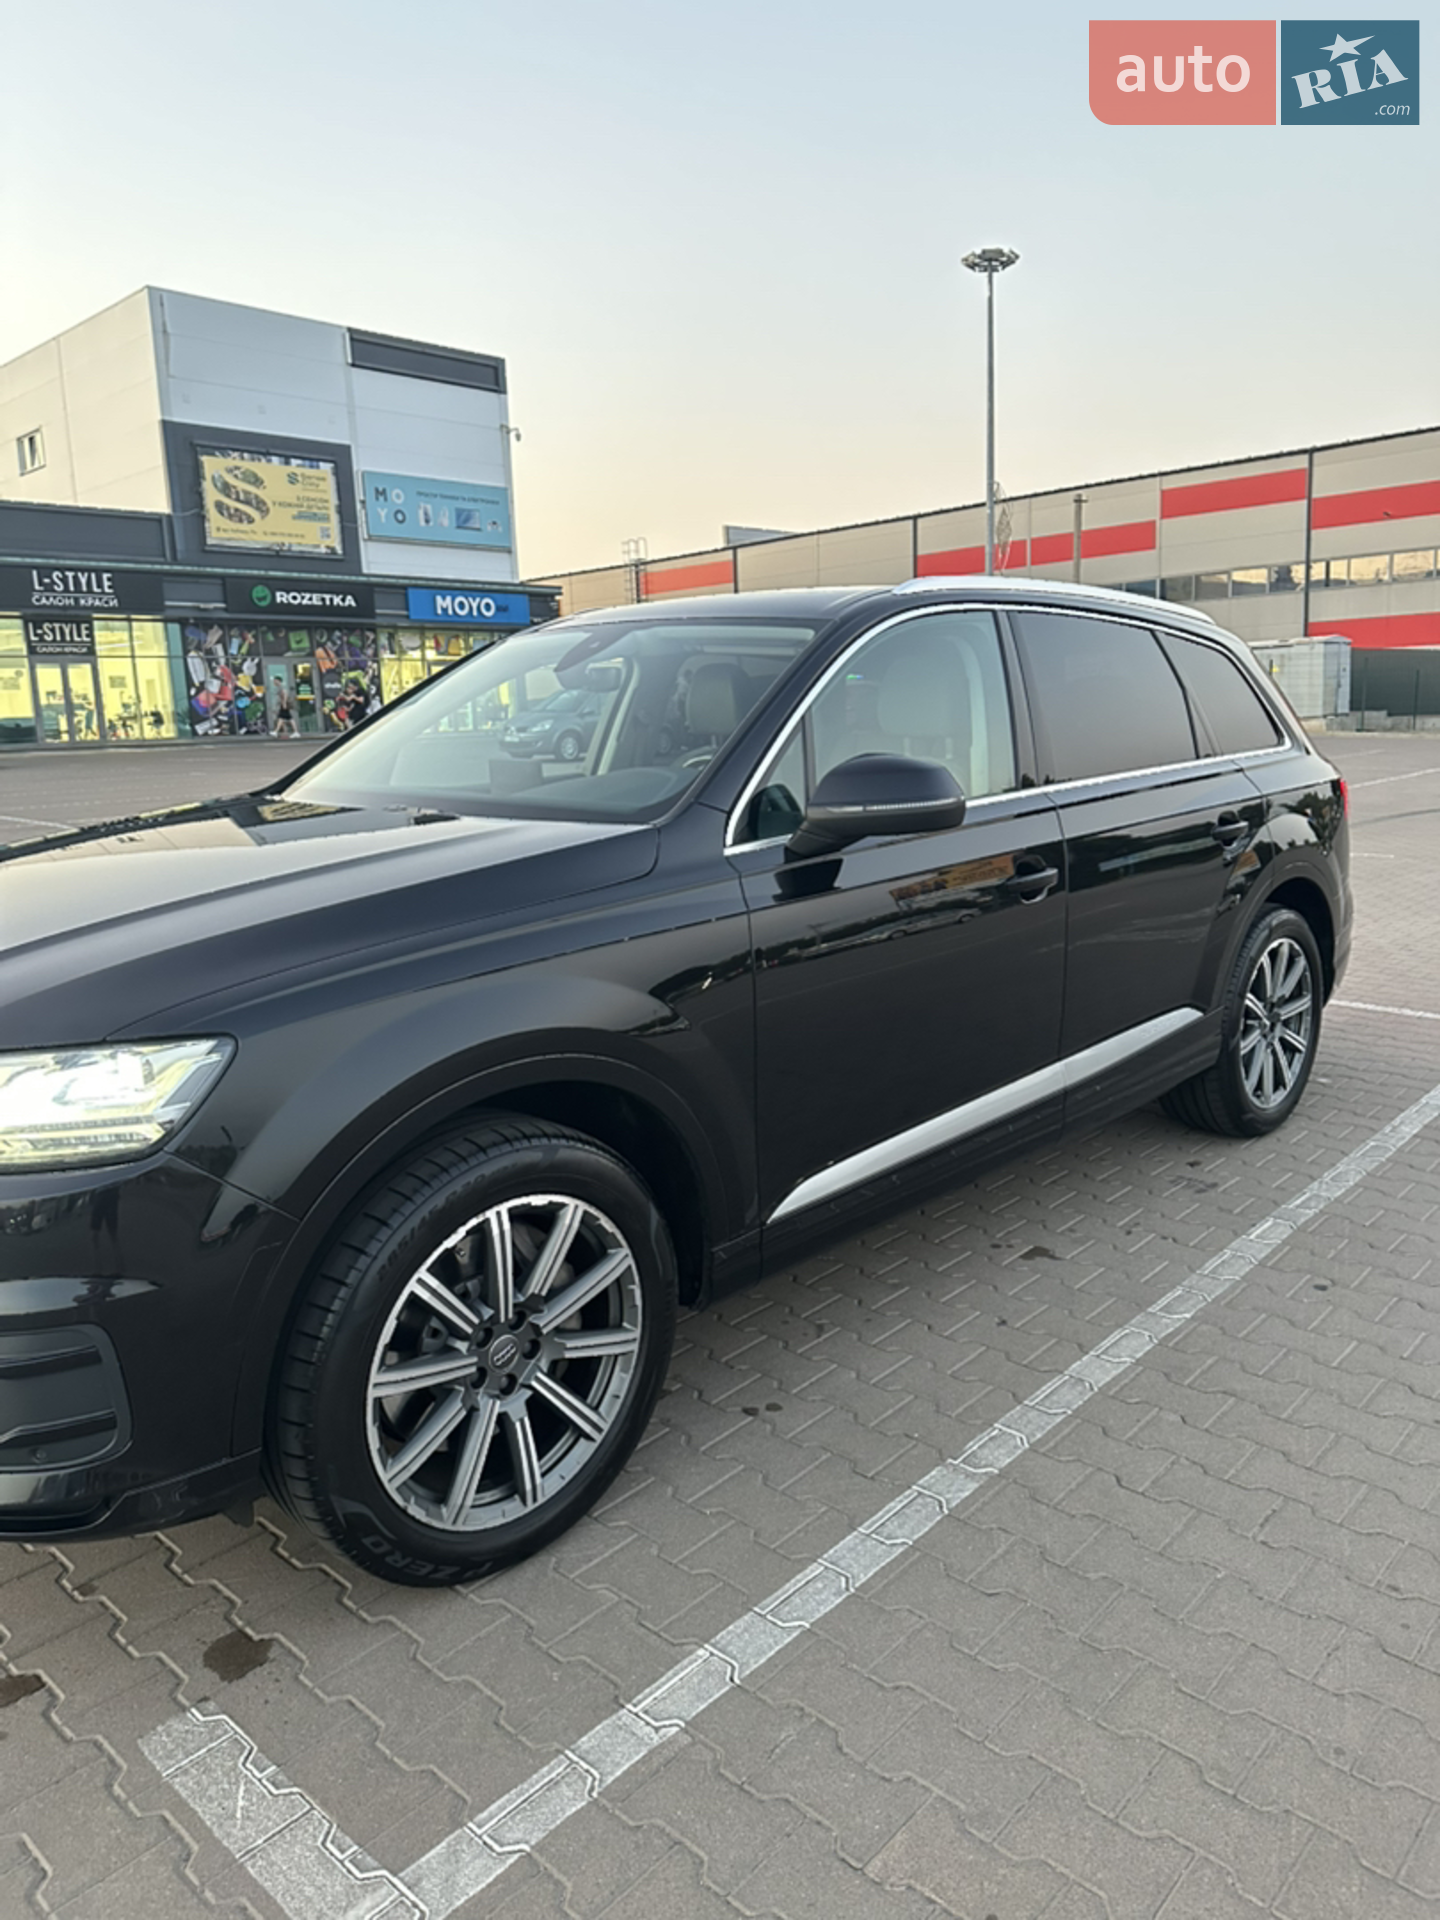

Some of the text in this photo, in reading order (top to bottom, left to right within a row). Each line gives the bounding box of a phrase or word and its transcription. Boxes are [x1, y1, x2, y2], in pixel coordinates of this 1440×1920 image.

[32, 569, 115, 593] L-STYLE
[31, 595, 119, 608] САЛОН КРАСИ
[275, 591, 357, 607] ROZETKA
[435, 595, 496, 618] MOYO
[28, 622, 91, 642] L-STYLE
